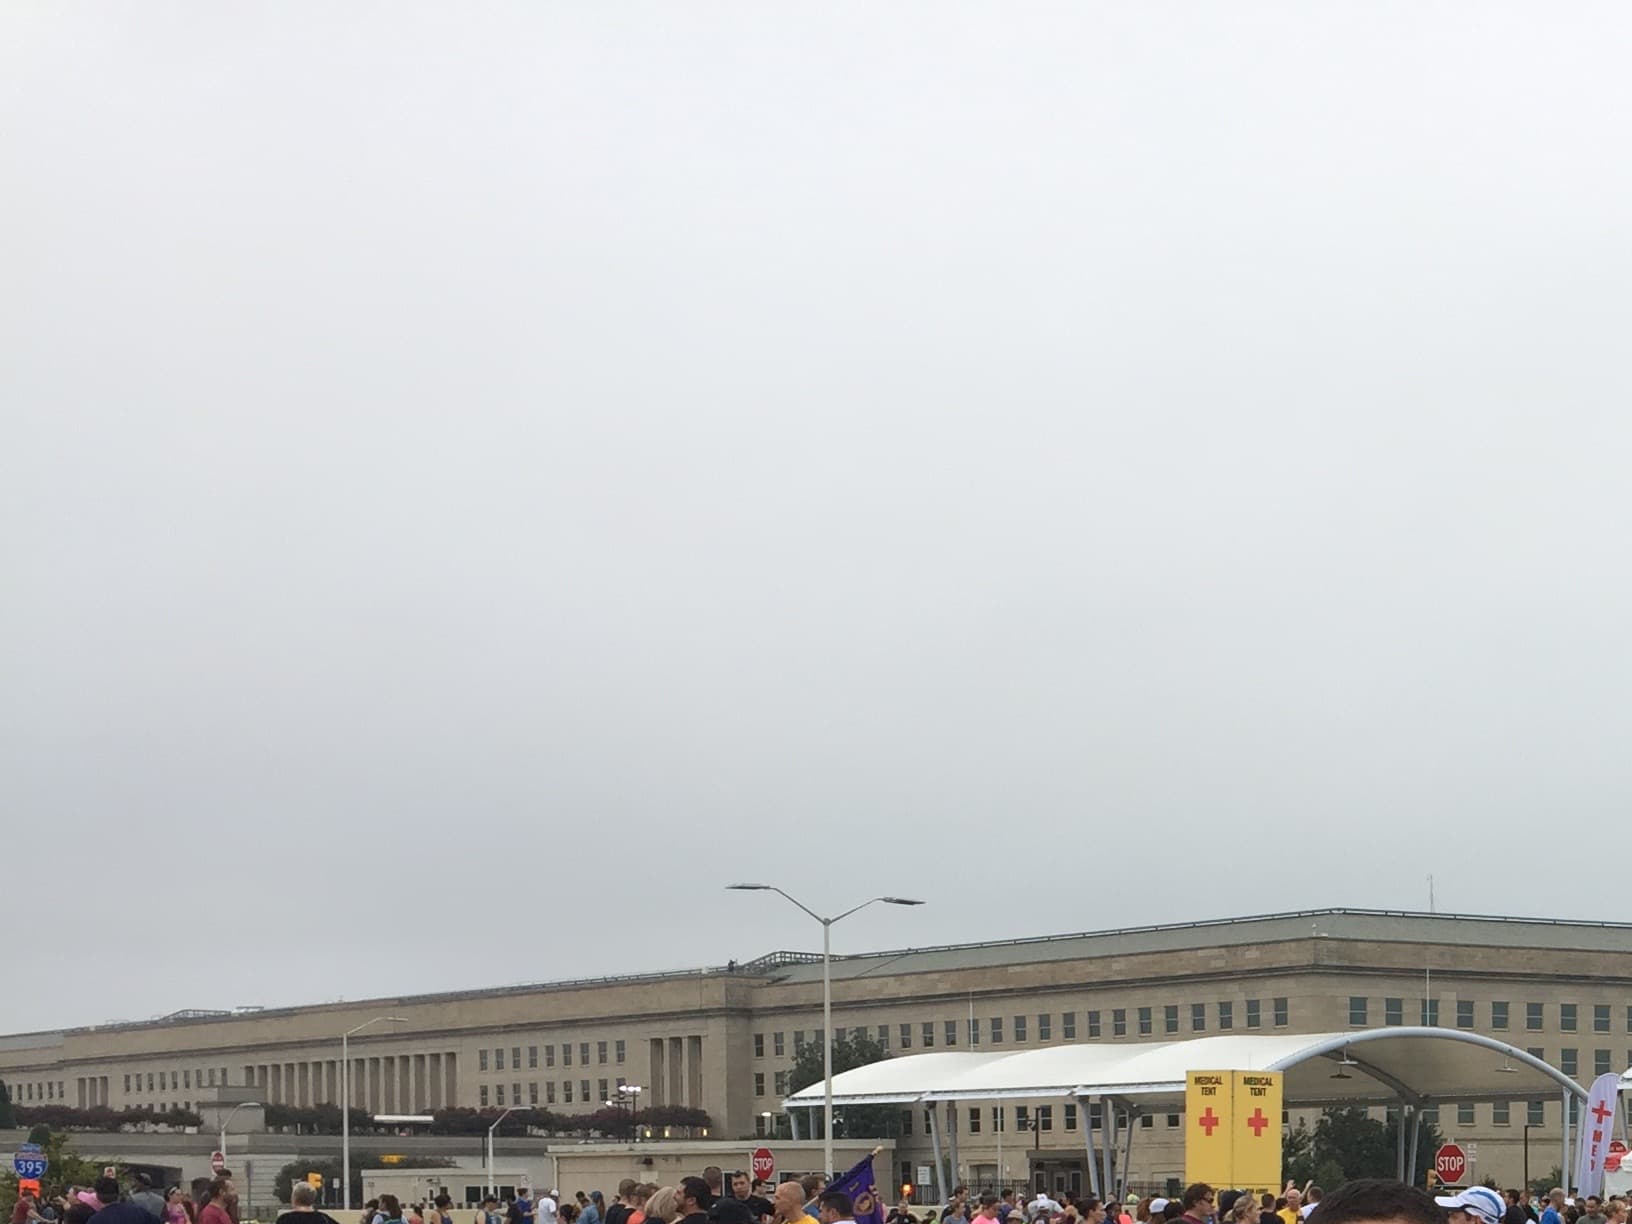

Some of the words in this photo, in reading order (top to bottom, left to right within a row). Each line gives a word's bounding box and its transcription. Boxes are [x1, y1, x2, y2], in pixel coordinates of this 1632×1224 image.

[1194, 1076, 1223, 1085] MEDICAL
[1243, 1076, 1273, 1086] MEDICAL
[1201, 1087, 1216, 1096] TENT
[1250, 1088, 1266, 1096] TENT
[18, 1160, 43, 1175] 395
[753, 1157, 773, 1171] STOP
[1438, 1156, 1464, 1171] STOP
